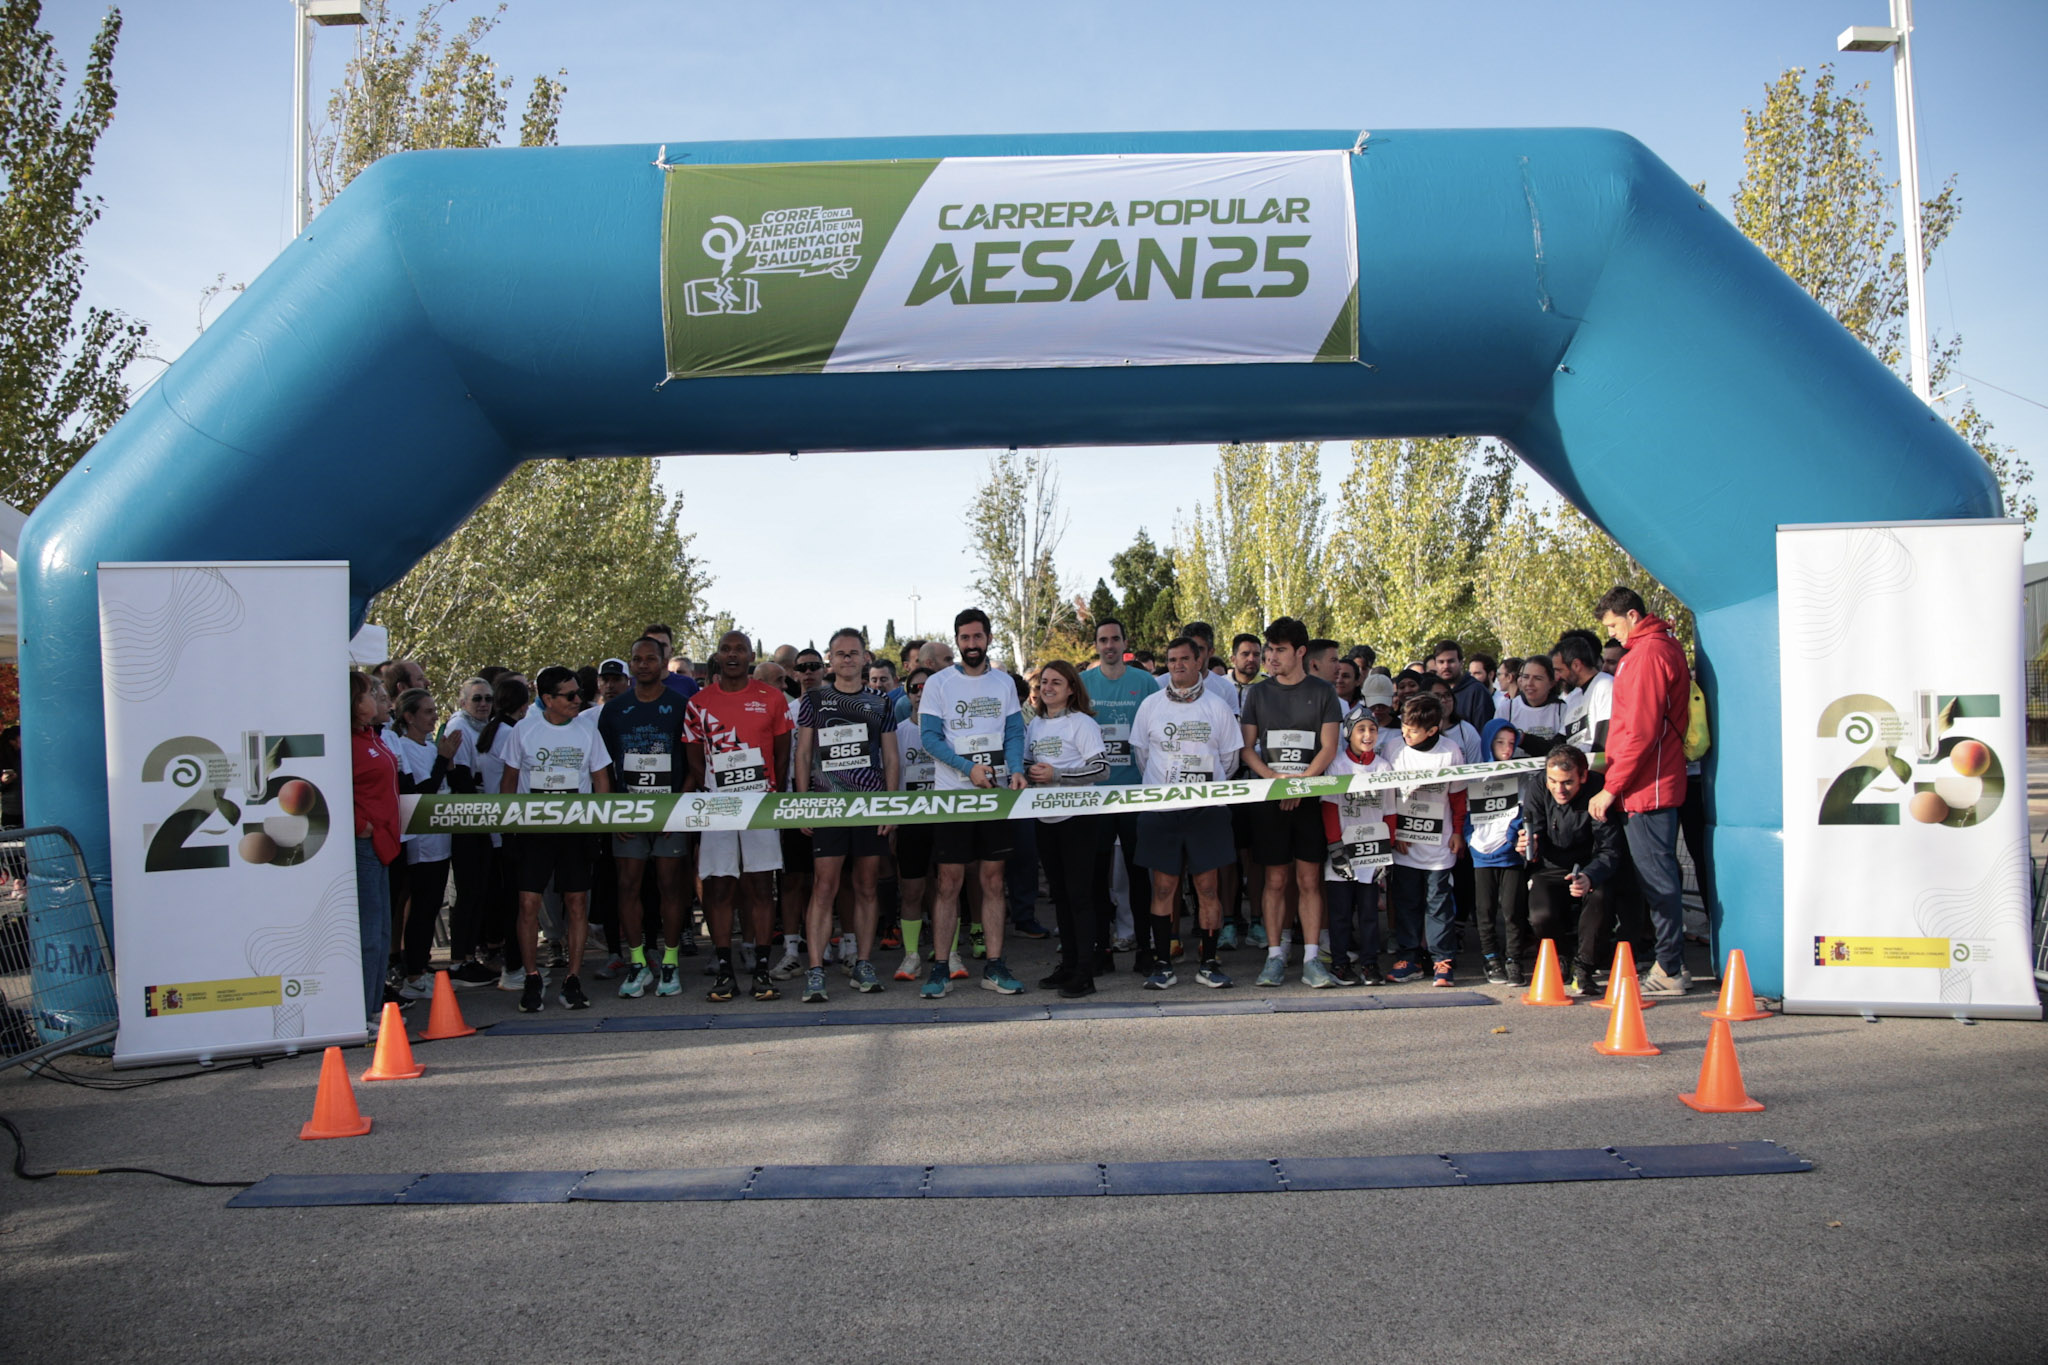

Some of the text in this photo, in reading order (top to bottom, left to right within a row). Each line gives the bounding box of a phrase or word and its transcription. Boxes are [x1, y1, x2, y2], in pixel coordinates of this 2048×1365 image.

[764, 208, 851, 224] CORRE CON LA
[938, 197, 1310, 231] CARRERA POPULAR
[826, 223, 838, 231] DE
[841, 221, 860, 230] UNA
[750, 230, 859, 254] ALIMENTACIÓN
[758, 245, 851, 267] SALUDABLE
[904, 235, 1312, 306] AESAN25
[829, 743, 861, 758] 866
[1280, 749, 1302, 762] 28
[838, 758, 868, 767] AESAN25
[972, 752, 992, 766] 93
[638, 773, 656, 785] 21
[724, 768, 756, 785] 238
[1368, 774, 1433, 784] POPULAR
[1036, 791, 1102, 801] CARRERA
[1102, 783, 1250, 806] AESAN25
[434, 803, 501, 815] CARRERA
[779, 798, 847, 808] CARRERA
[845, 795, 999, 818] AESAN25
[1031, 799, 1099, 810] POPULAR
[1485, 798, 1507, 811] 80
[501, 799, 655, 825] AESAN25
[773, 808, 843, 820] POPULAR
[429, 814, 498, 826] POPULAR
[1403, 817, 1435, 831] 360
[1409, 834, 1439, 842] AESAN25
[1355, 842, 1380, 856] 331
[1359, 857, 1390, 865] AESAN25
